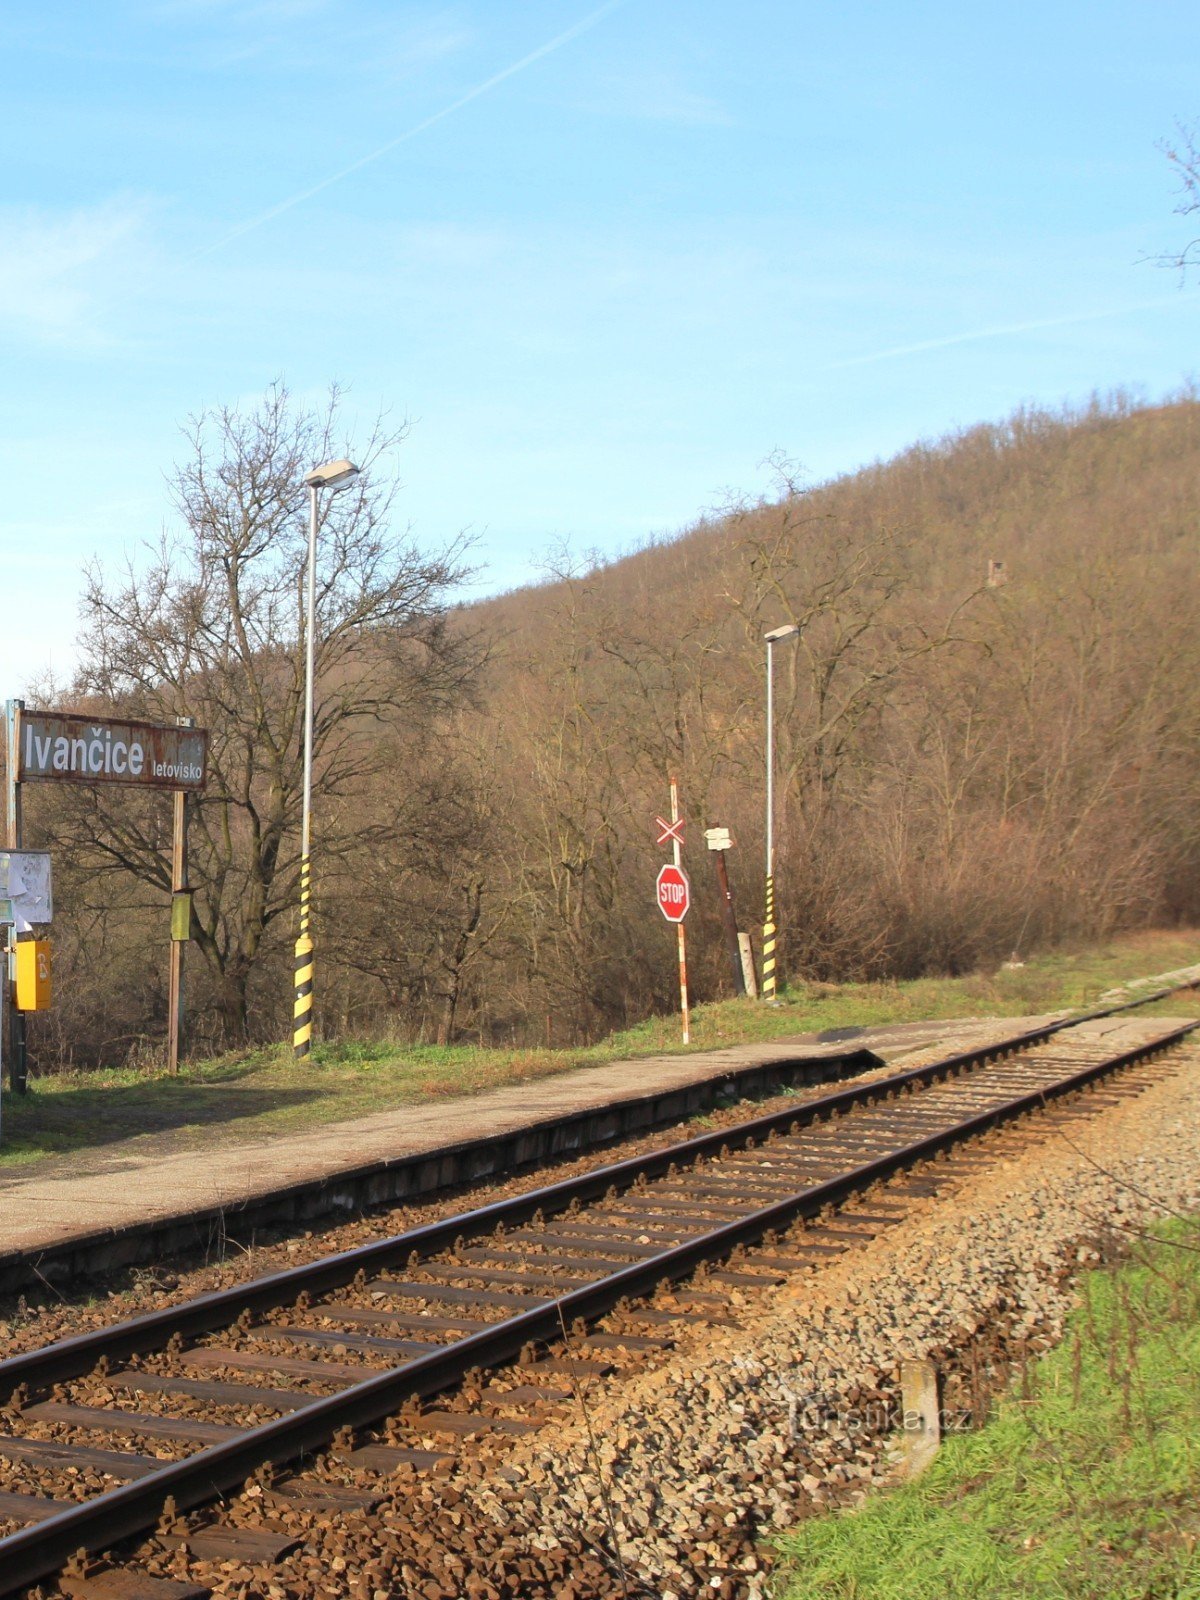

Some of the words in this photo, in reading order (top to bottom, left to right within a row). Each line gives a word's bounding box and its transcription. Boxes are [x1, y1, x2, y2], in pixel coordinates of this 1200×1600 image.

[25, 724, 145, 775] Ivančice
[153, 760, 202, 779] letovisko
[660, 883, 684, 904] STOP
